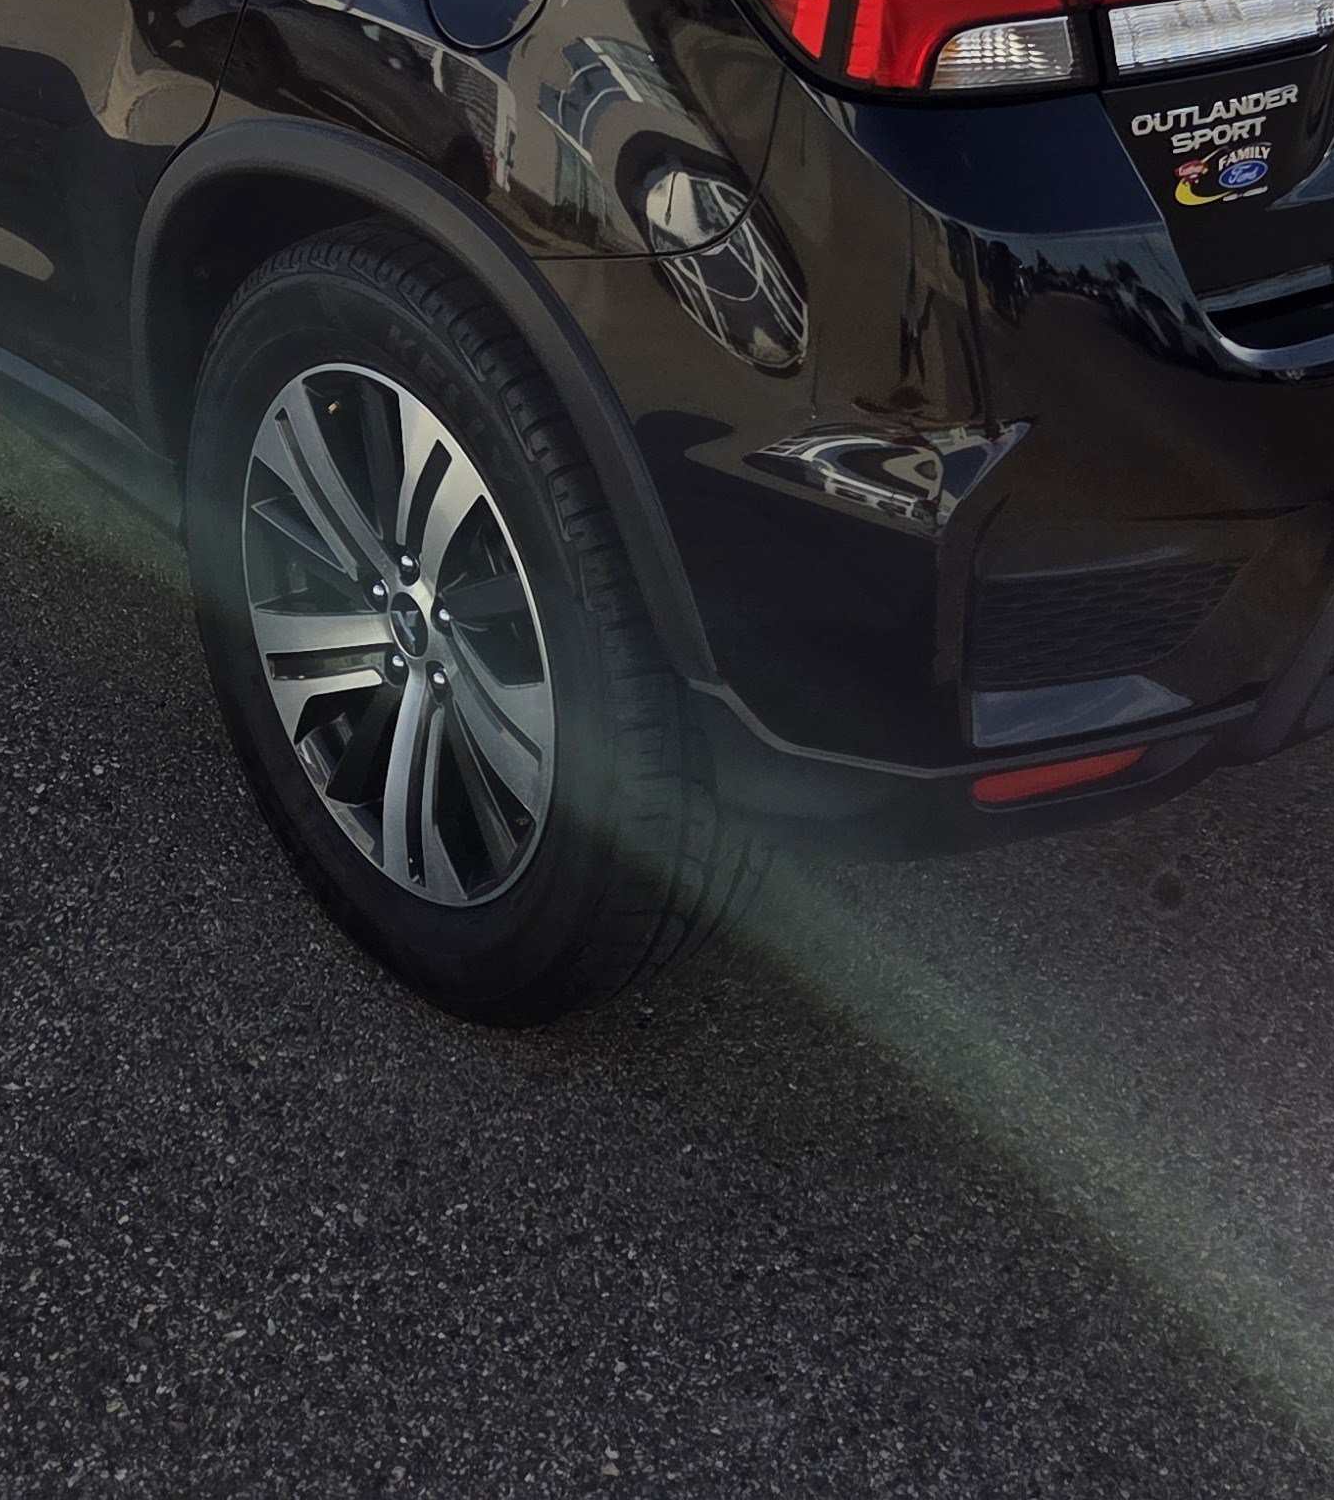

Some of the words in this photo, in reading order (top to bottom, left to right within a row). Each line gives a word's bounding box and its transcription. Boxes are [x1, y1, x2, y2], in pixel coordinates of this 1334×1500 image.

[1131, 83, 1299, 137] OUTLANDER
[1170, 116, 1267, 154] SPORT
[1218, 146, 1271, 171] FAMILY
[1228, 165, 1260, 184] Ford
